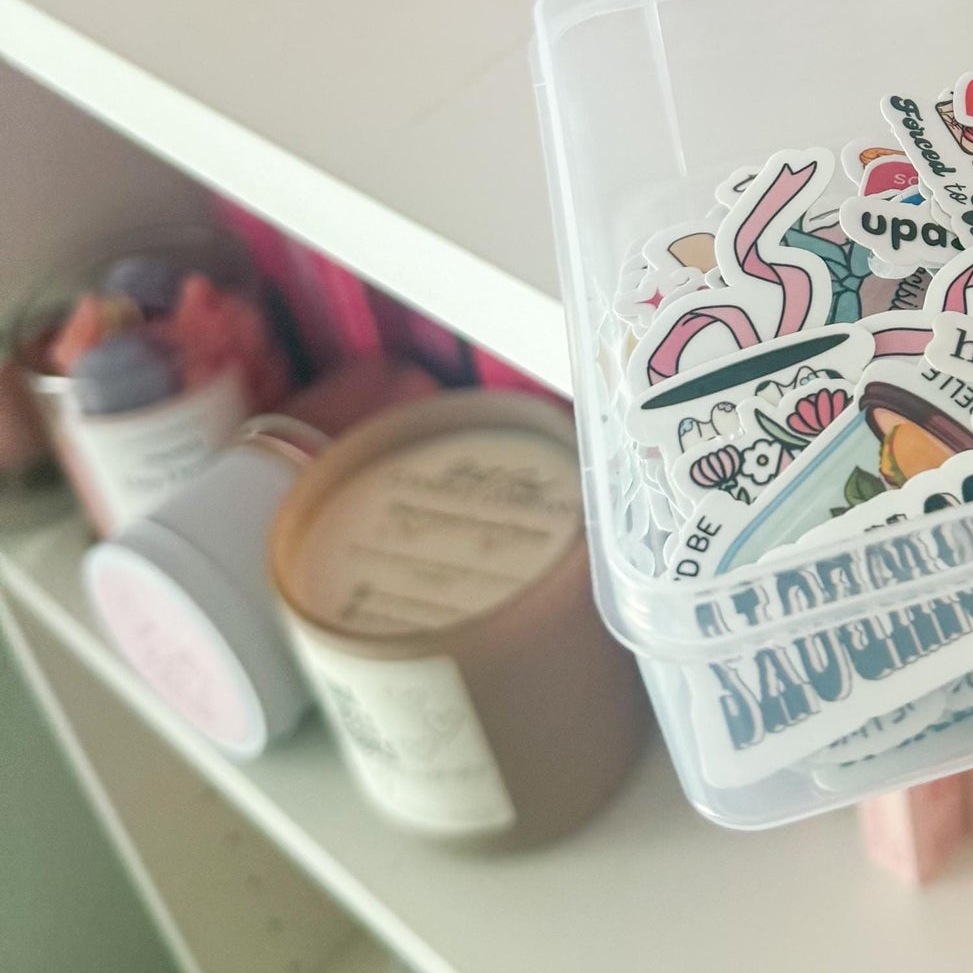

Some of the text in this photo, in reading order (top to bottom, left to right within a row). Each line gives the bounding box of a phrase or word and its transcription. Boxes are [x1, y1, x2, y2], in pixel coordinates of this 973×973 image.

[889, 94, 957, 178] Forced
[943, 183, 968, 205] to
[861, 211, 966, 251] upa
[695, 515, 723, 554] BE
